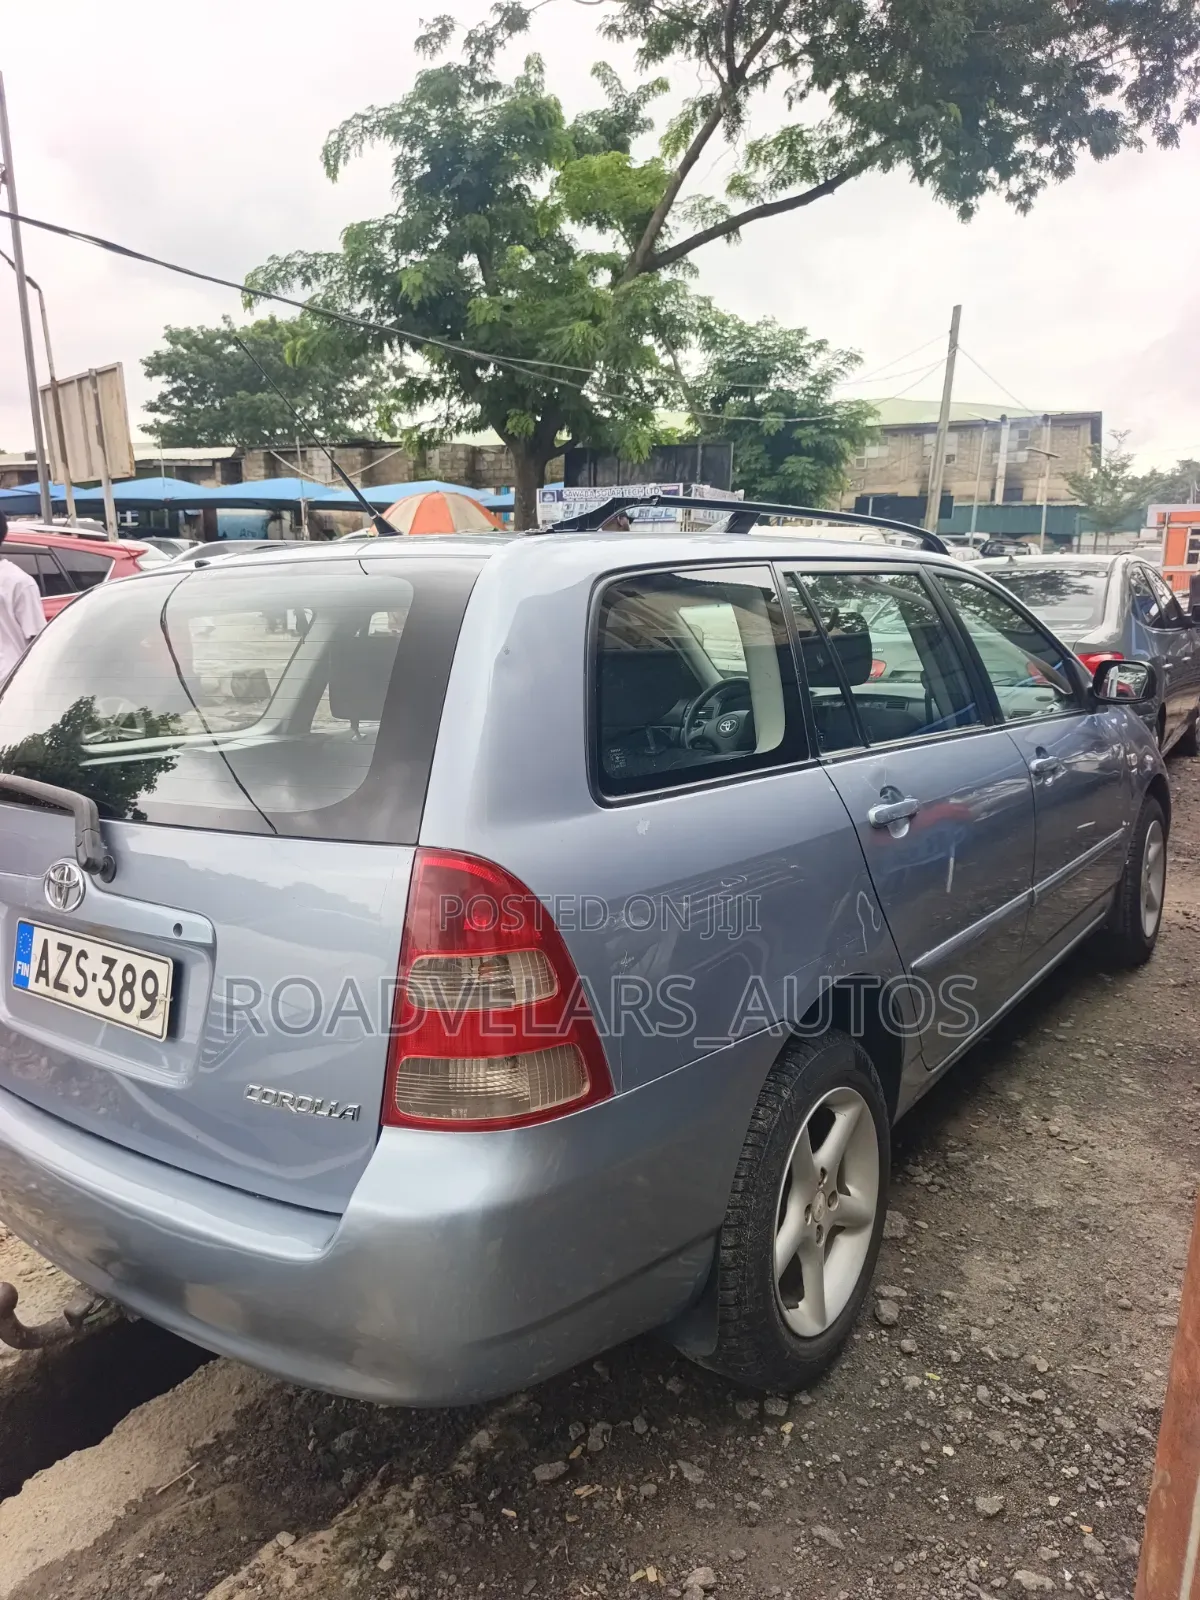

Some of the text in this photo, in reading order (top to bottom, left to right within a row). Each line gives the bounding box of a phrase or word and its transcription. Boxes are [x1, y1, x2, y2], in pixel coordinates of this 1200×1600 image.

[596, 488, 622, 497] SOLAR
[624, 487, 644, 496] TECH
[16, 960, 31, 978] FIN
[34, 938, 160, 1020] AZS-389
[244, 1084, 361, 1121] COROLLA
